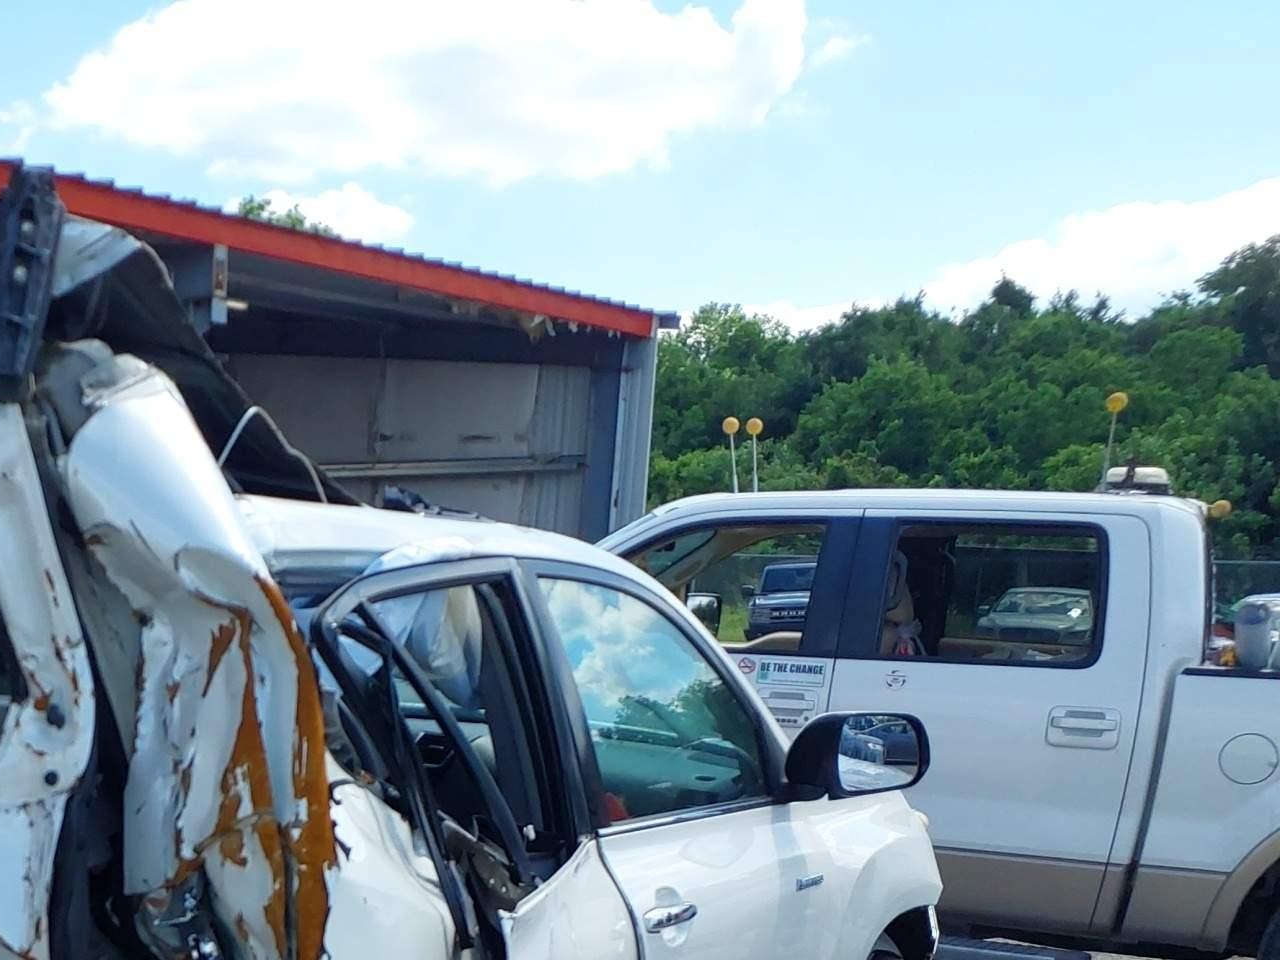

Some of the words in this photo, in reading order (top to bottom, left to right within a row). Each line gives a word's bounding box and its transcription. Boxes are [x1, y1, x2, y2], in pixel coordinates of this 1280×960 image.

[761, 662, 772, 672] BE
[773, 662, 789, 673] THE
[789, 663, 825, 675] CHANGE
